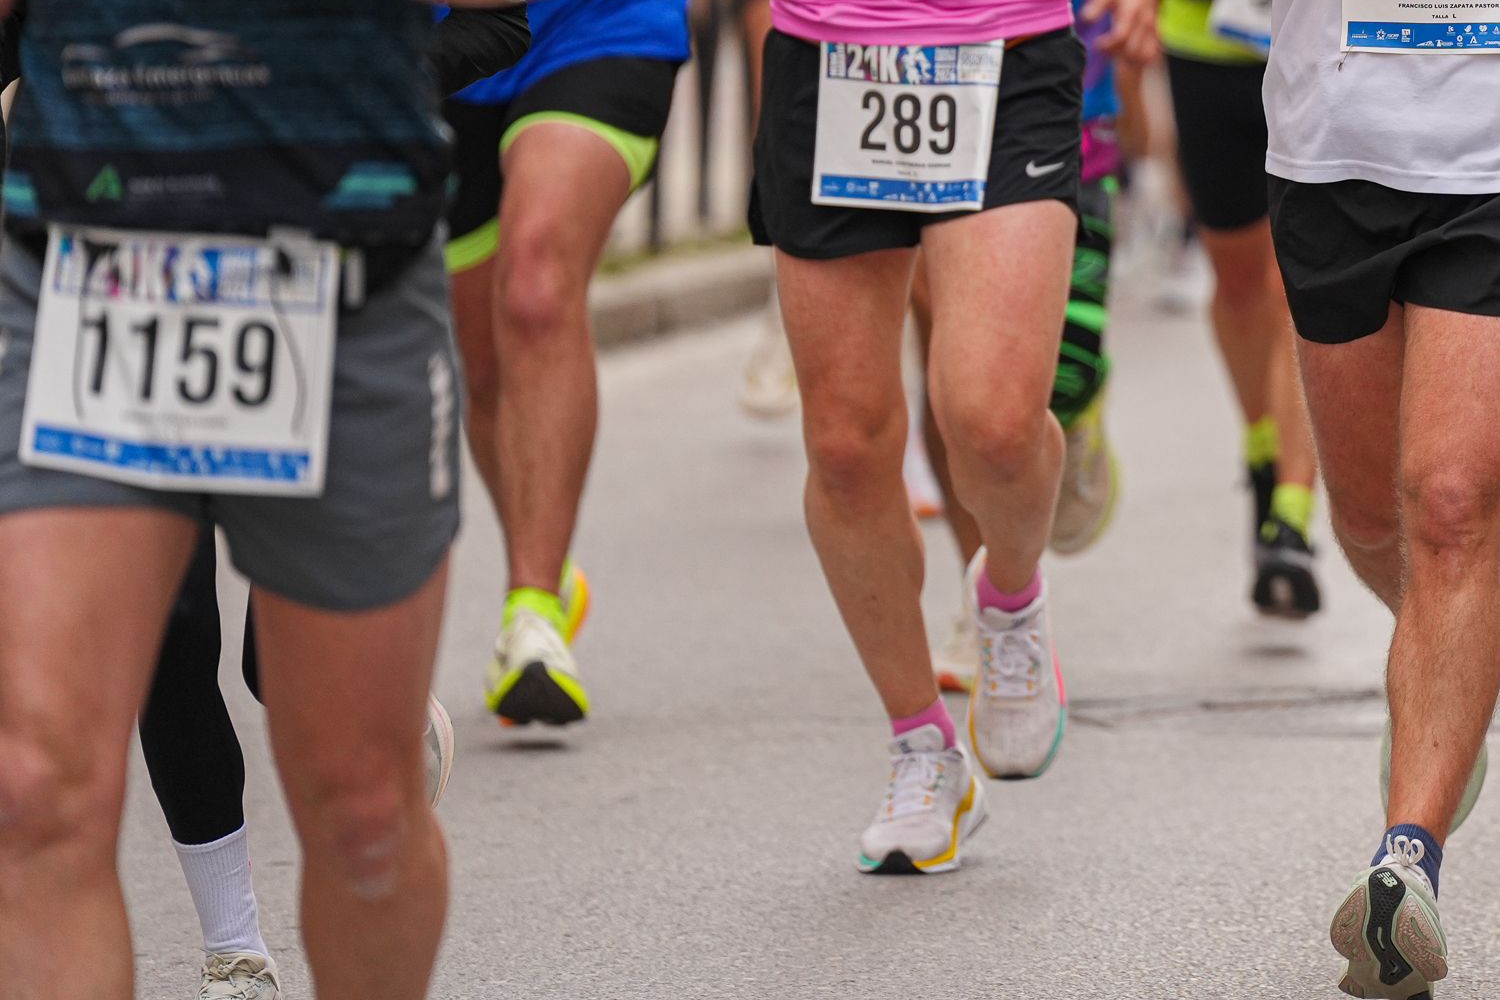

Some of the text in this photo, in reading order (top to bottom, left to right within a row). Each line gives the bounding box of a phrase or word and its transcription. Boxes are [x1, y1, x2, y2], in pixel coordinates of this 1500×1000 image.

[847, 43, 900, 83] 21K
[860, 89, 956, 155] 289
[82, 311, 275, 407] 1159
